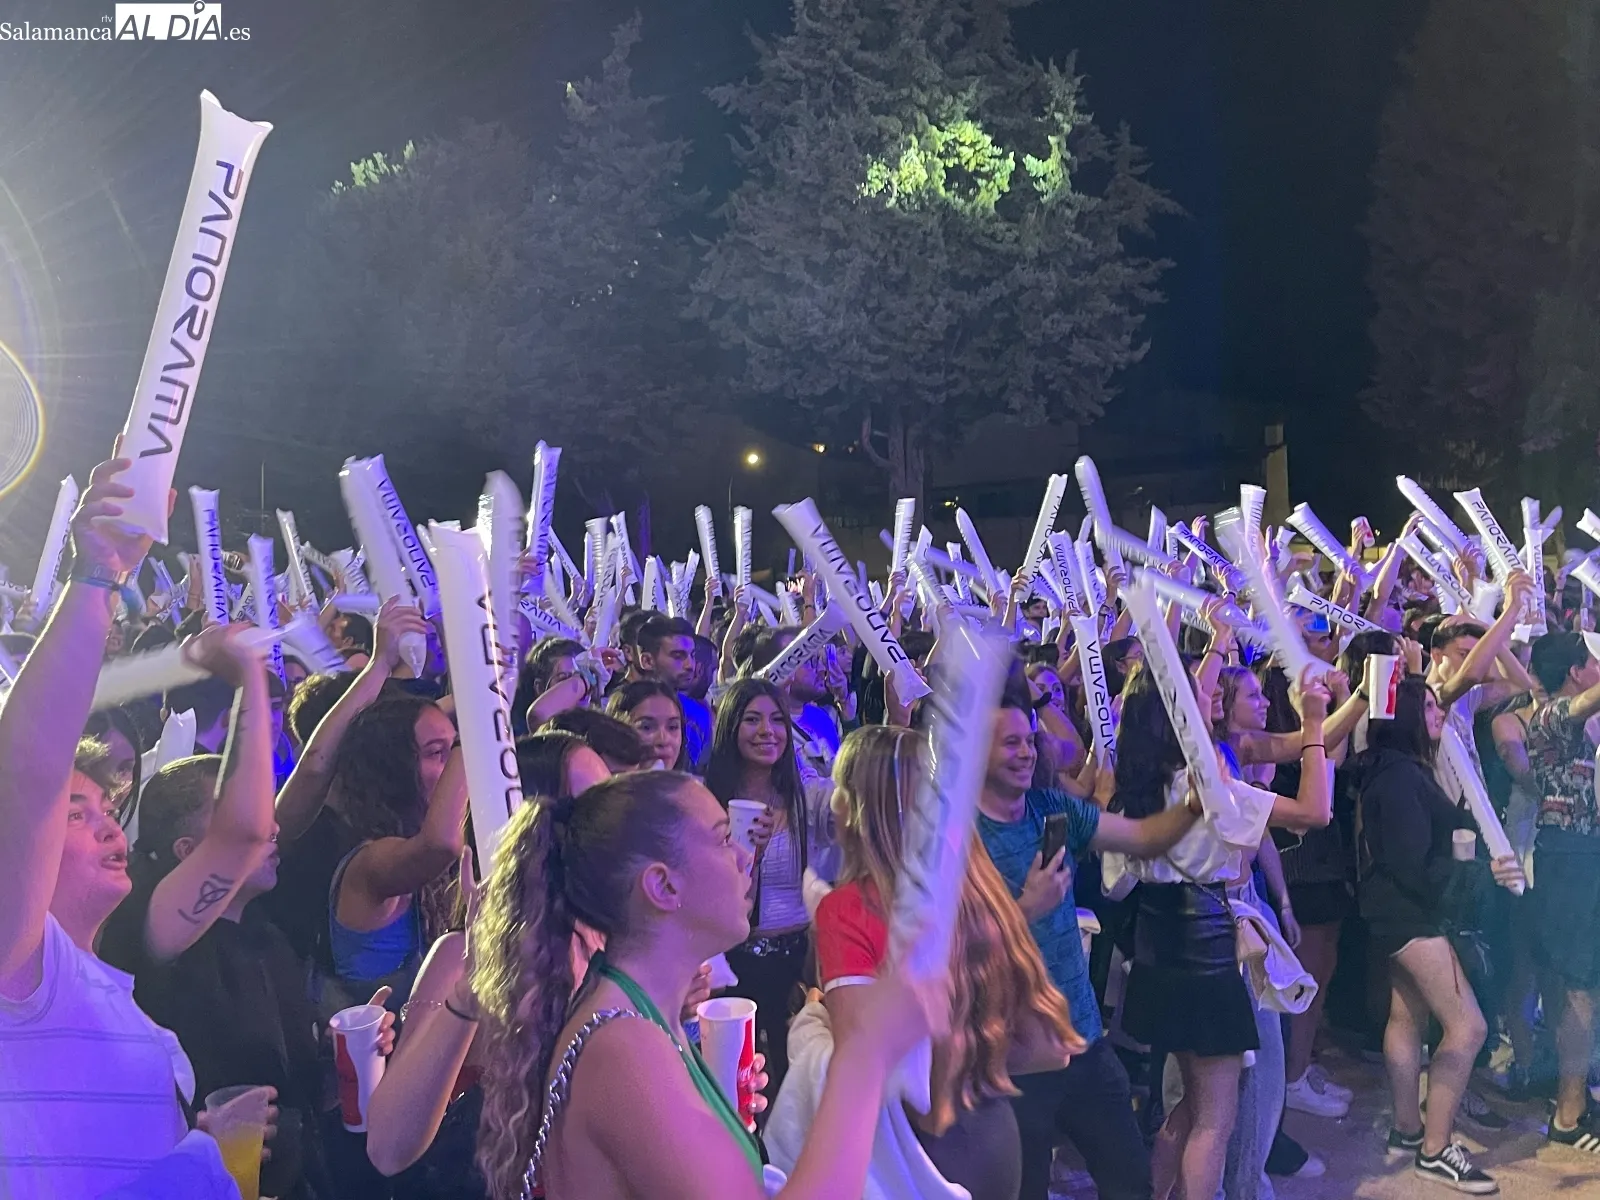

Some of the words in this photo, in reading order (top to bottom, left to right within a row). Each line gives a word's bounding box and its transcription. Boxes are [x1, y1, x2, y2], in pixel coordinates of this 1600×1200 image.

[139, 160, 243, 458] PANORAMA
[203, 508, 228, 619] PANORAMA
[376, 477, 437, 589] PANORAMA
[1028, 495, 1061, 584] PANORAMA
[1054, 543, 1077, 612] PANORAMA
[1181, 529, 1231, 571] PANORAM
[812, 523, 905, 664] PANORAMA
[769, 628, 834, 683] PANORAMA
